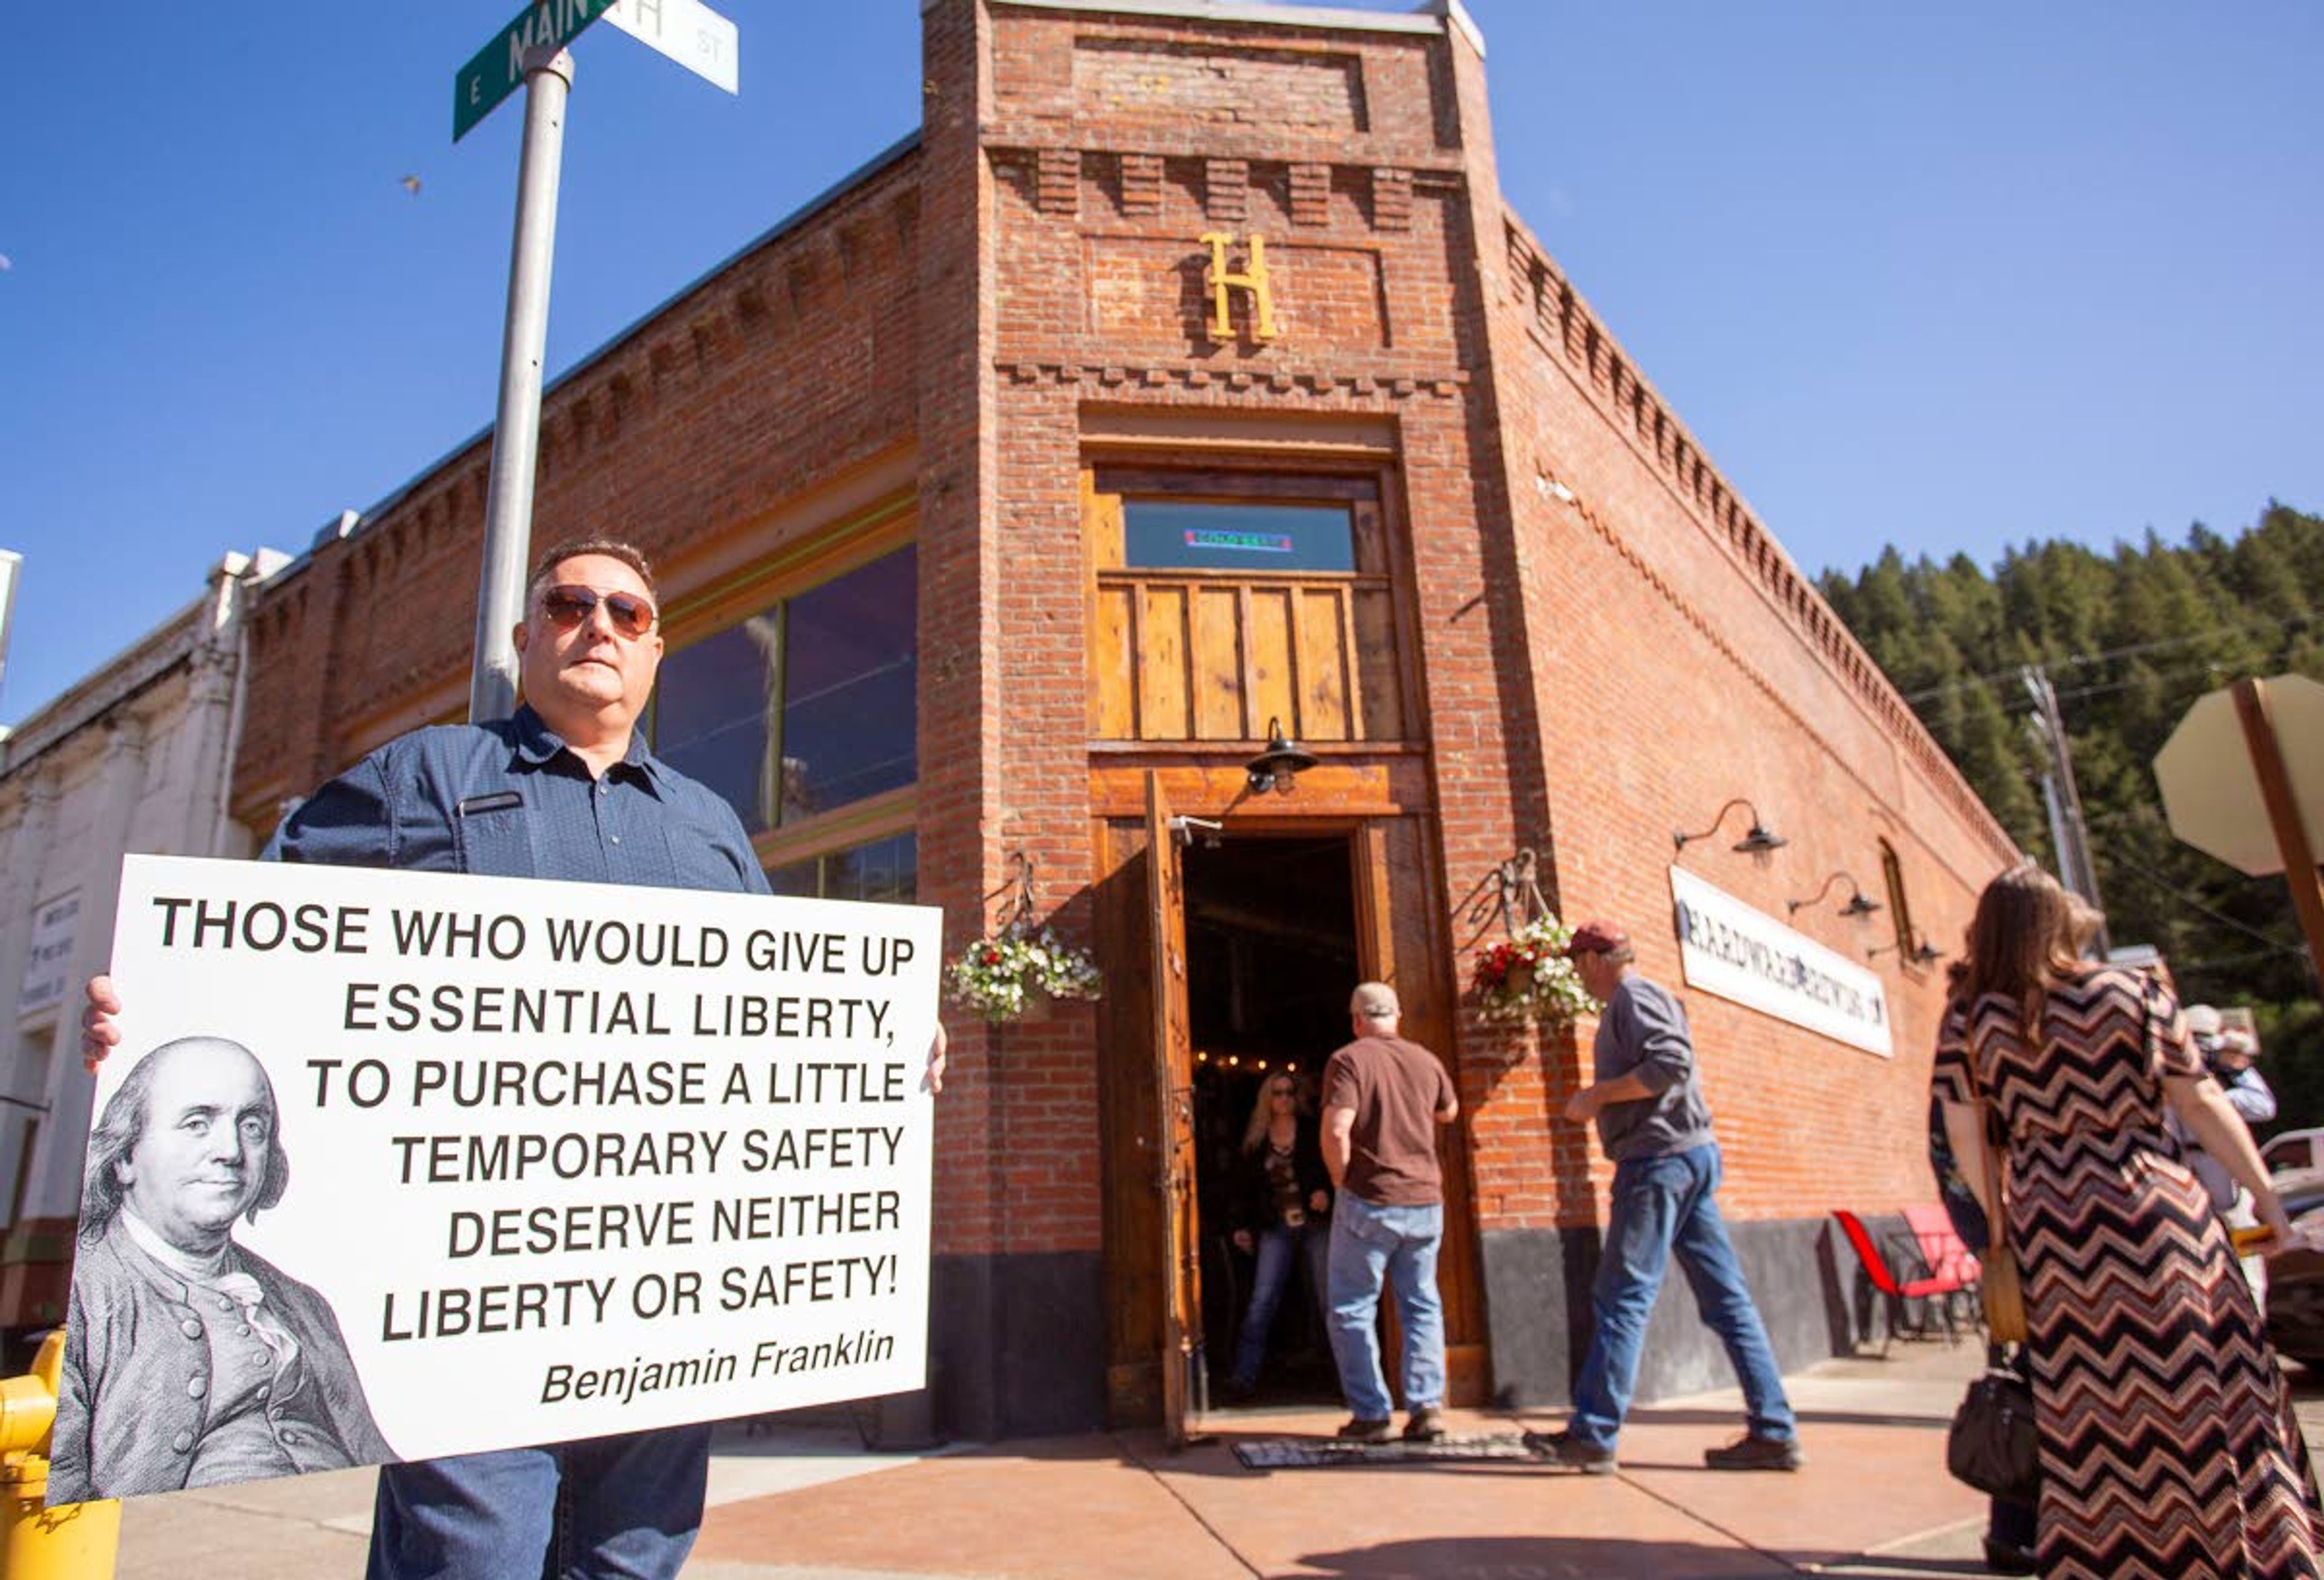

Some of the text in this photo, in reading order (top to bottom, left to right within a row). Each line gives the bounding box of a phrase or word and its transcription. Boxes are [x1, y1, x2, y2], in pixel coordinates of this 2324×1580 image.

[470, 0, 588, 105] E MAIN
[1200, 231, 1278, 338] H
[153, 897, 914, 976] THOSE WHO WOULD GIVE UP
[344, 983, 894, 1046] ESSENTIAL LIBERTY,
[307, 1059, 905, 1108] TO PURCHASE A LITTLE
[392, 1126, 904, 1184] TEMPORARY SAFETY
[448, 1190, 899, 1259] DESERVE NEITHER
[382, 1254, 897, 1342] LIBERTY OR SAFETY!
[540, 1331, 894, 1405] Benjamin Franklin
